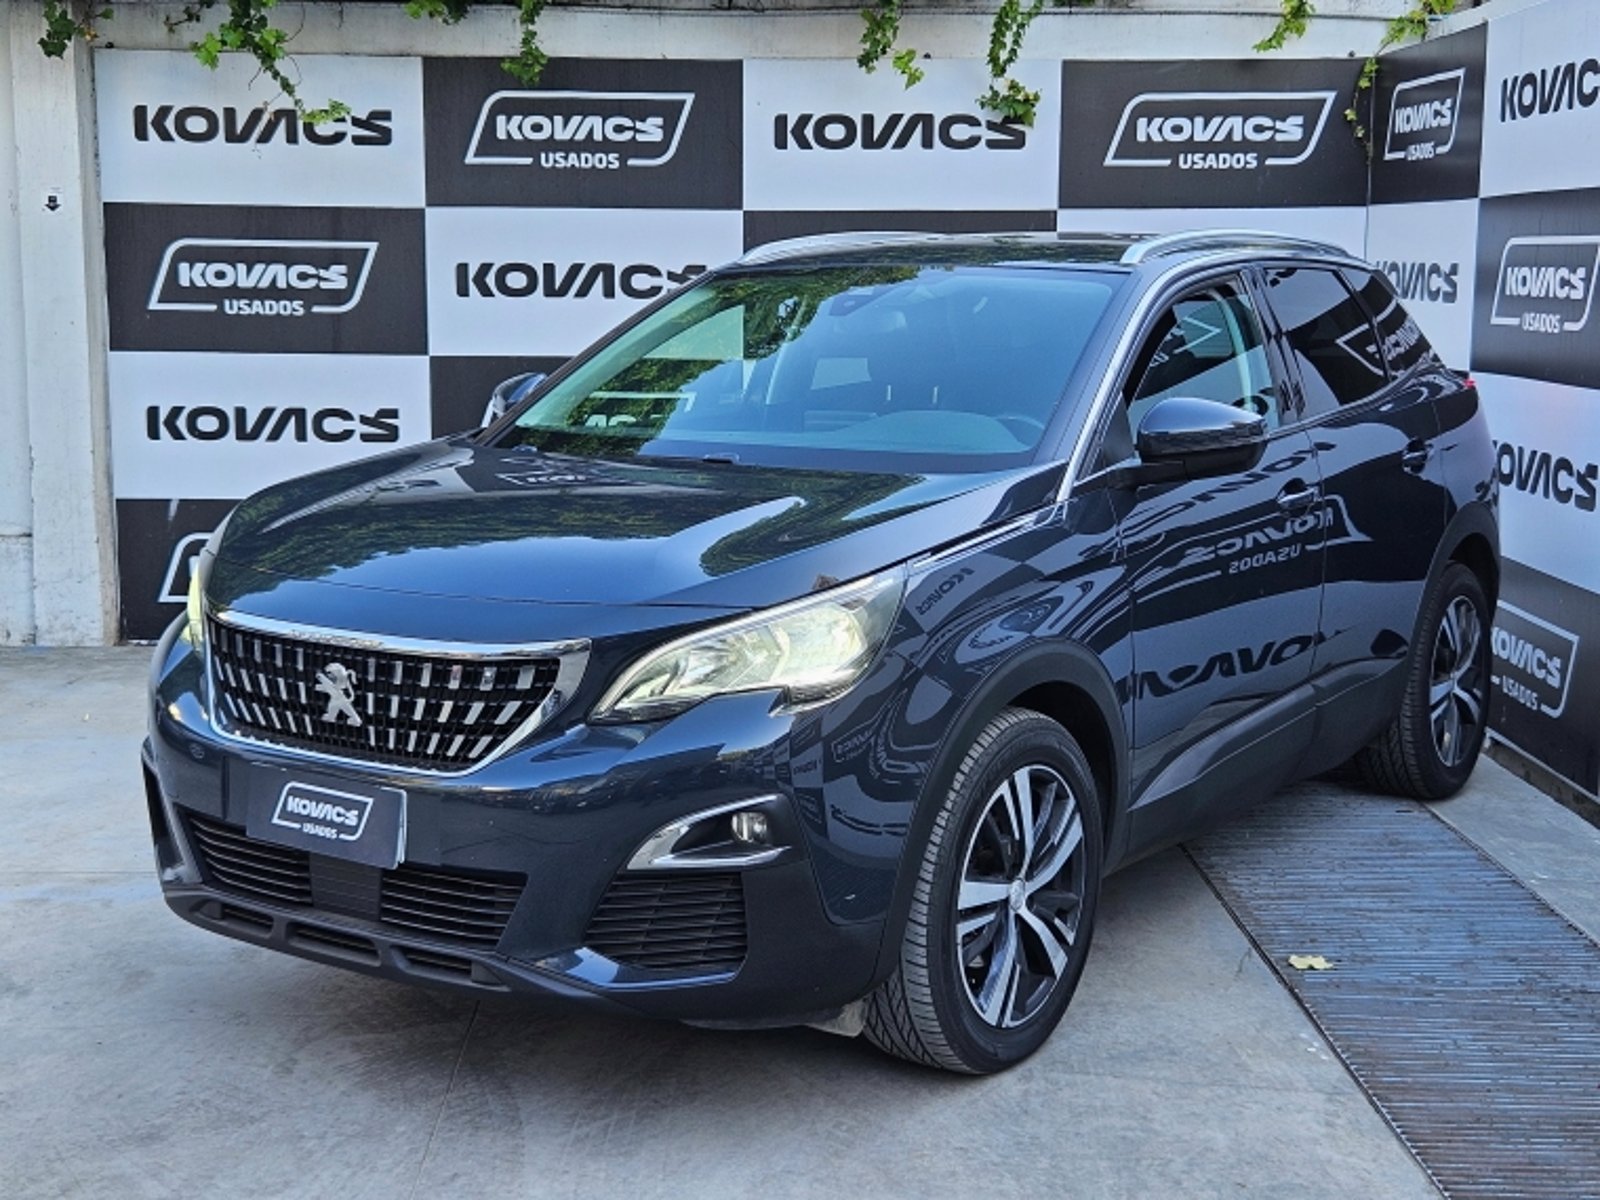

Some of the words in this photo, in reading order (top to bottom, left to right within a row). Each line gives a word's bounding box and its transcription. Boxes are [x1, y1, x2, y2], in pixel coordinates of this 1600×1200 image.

[133, 104, 393, 146] KOVACS
[495, 114, 665, 142] KOVACS
[774, 112, 1027, 150] KOVACS
[1136, 115, 1304, 143] KOVACS
[1394, 98, 1453, 134] KOVACS
[540, 151, 620, 169] USADOS
[1178, 152, 1258, 170] USADOS
[177, 261, 349, 290] KOVACS
[1376, 260, 1459, 304] OVACS
[1505, 266, 1586, 300] KOVACS
[223, 299, 305, 317] USADOS
[1521, 311, 1561, 334] USADOS
[146, 405, 400, 443] KOVACS
[1492, 439, 1599, 512] OVACS
[286, 796, 358, 826] KOVACS
